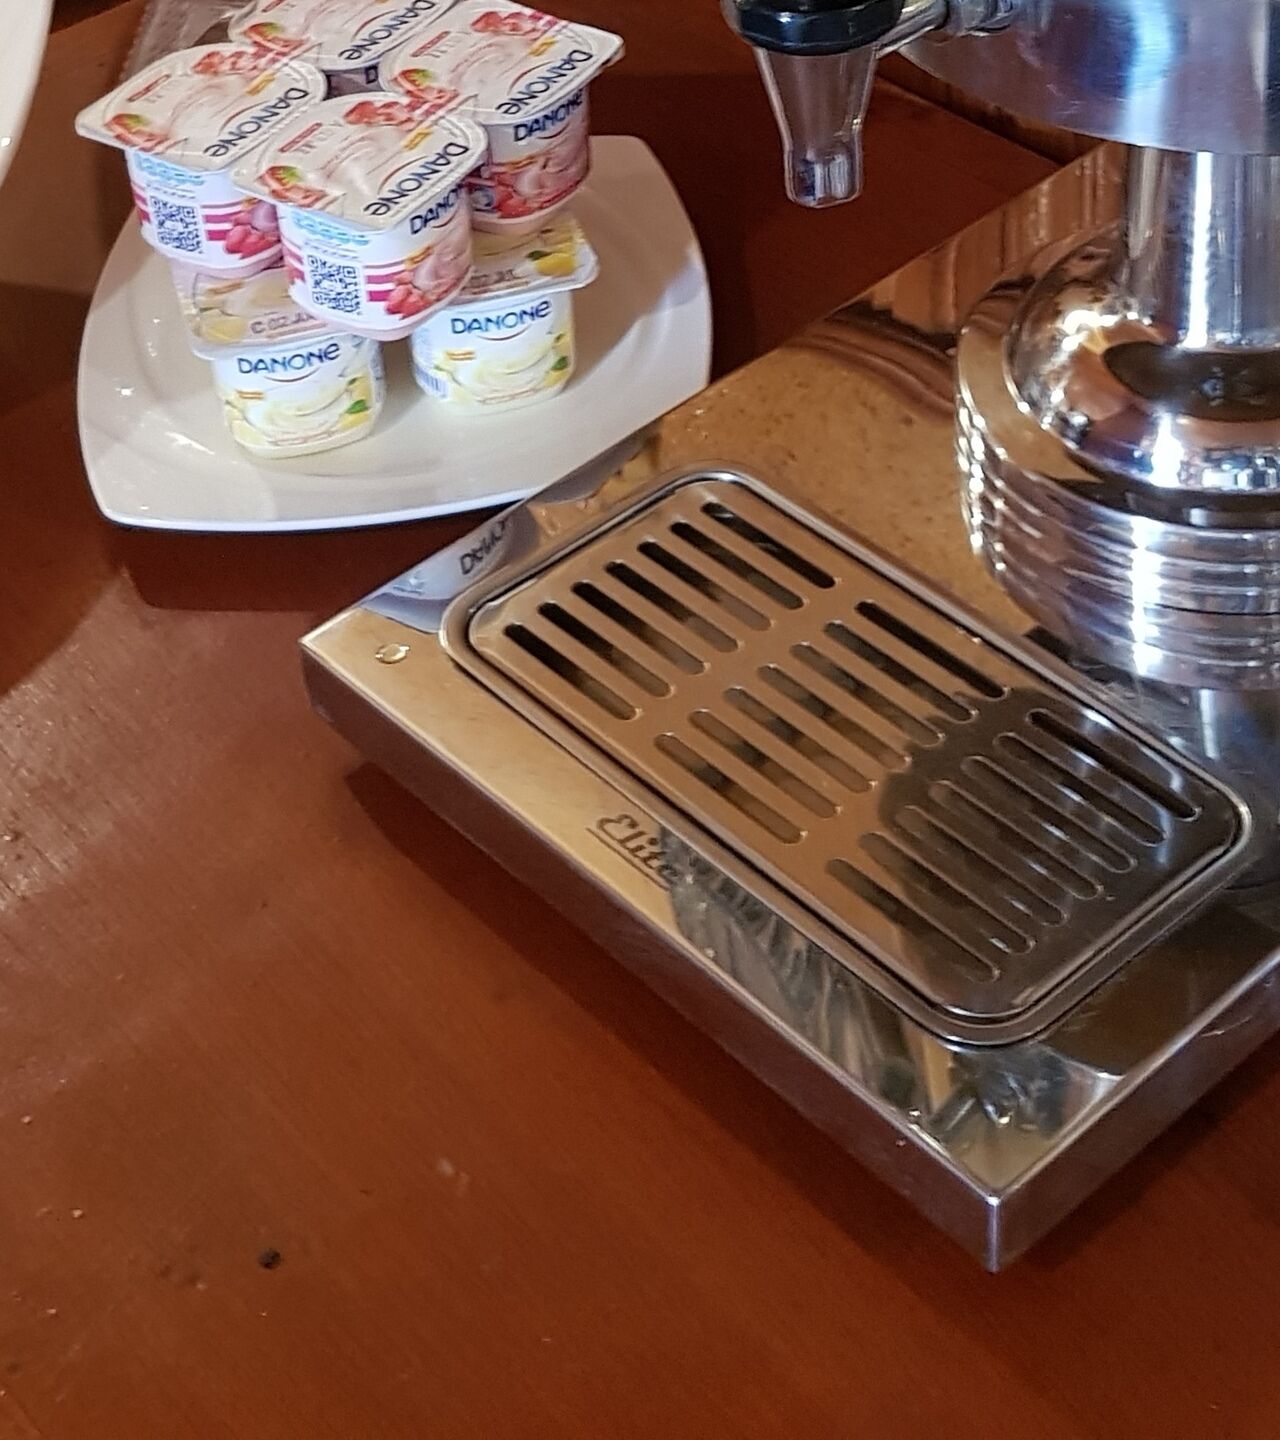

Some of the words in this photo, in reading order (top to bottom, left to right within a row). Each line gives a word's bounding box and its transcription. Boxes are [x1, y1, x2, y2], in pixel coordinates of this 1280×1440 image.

[495, 49, 592, 115] DANONE
[203, 87, 308, 157] DANONE
[363, 142, 470, 216] DANONE
[450, 299, 552, 334] DANONE
[237, 342, 341, 374] DANONE
